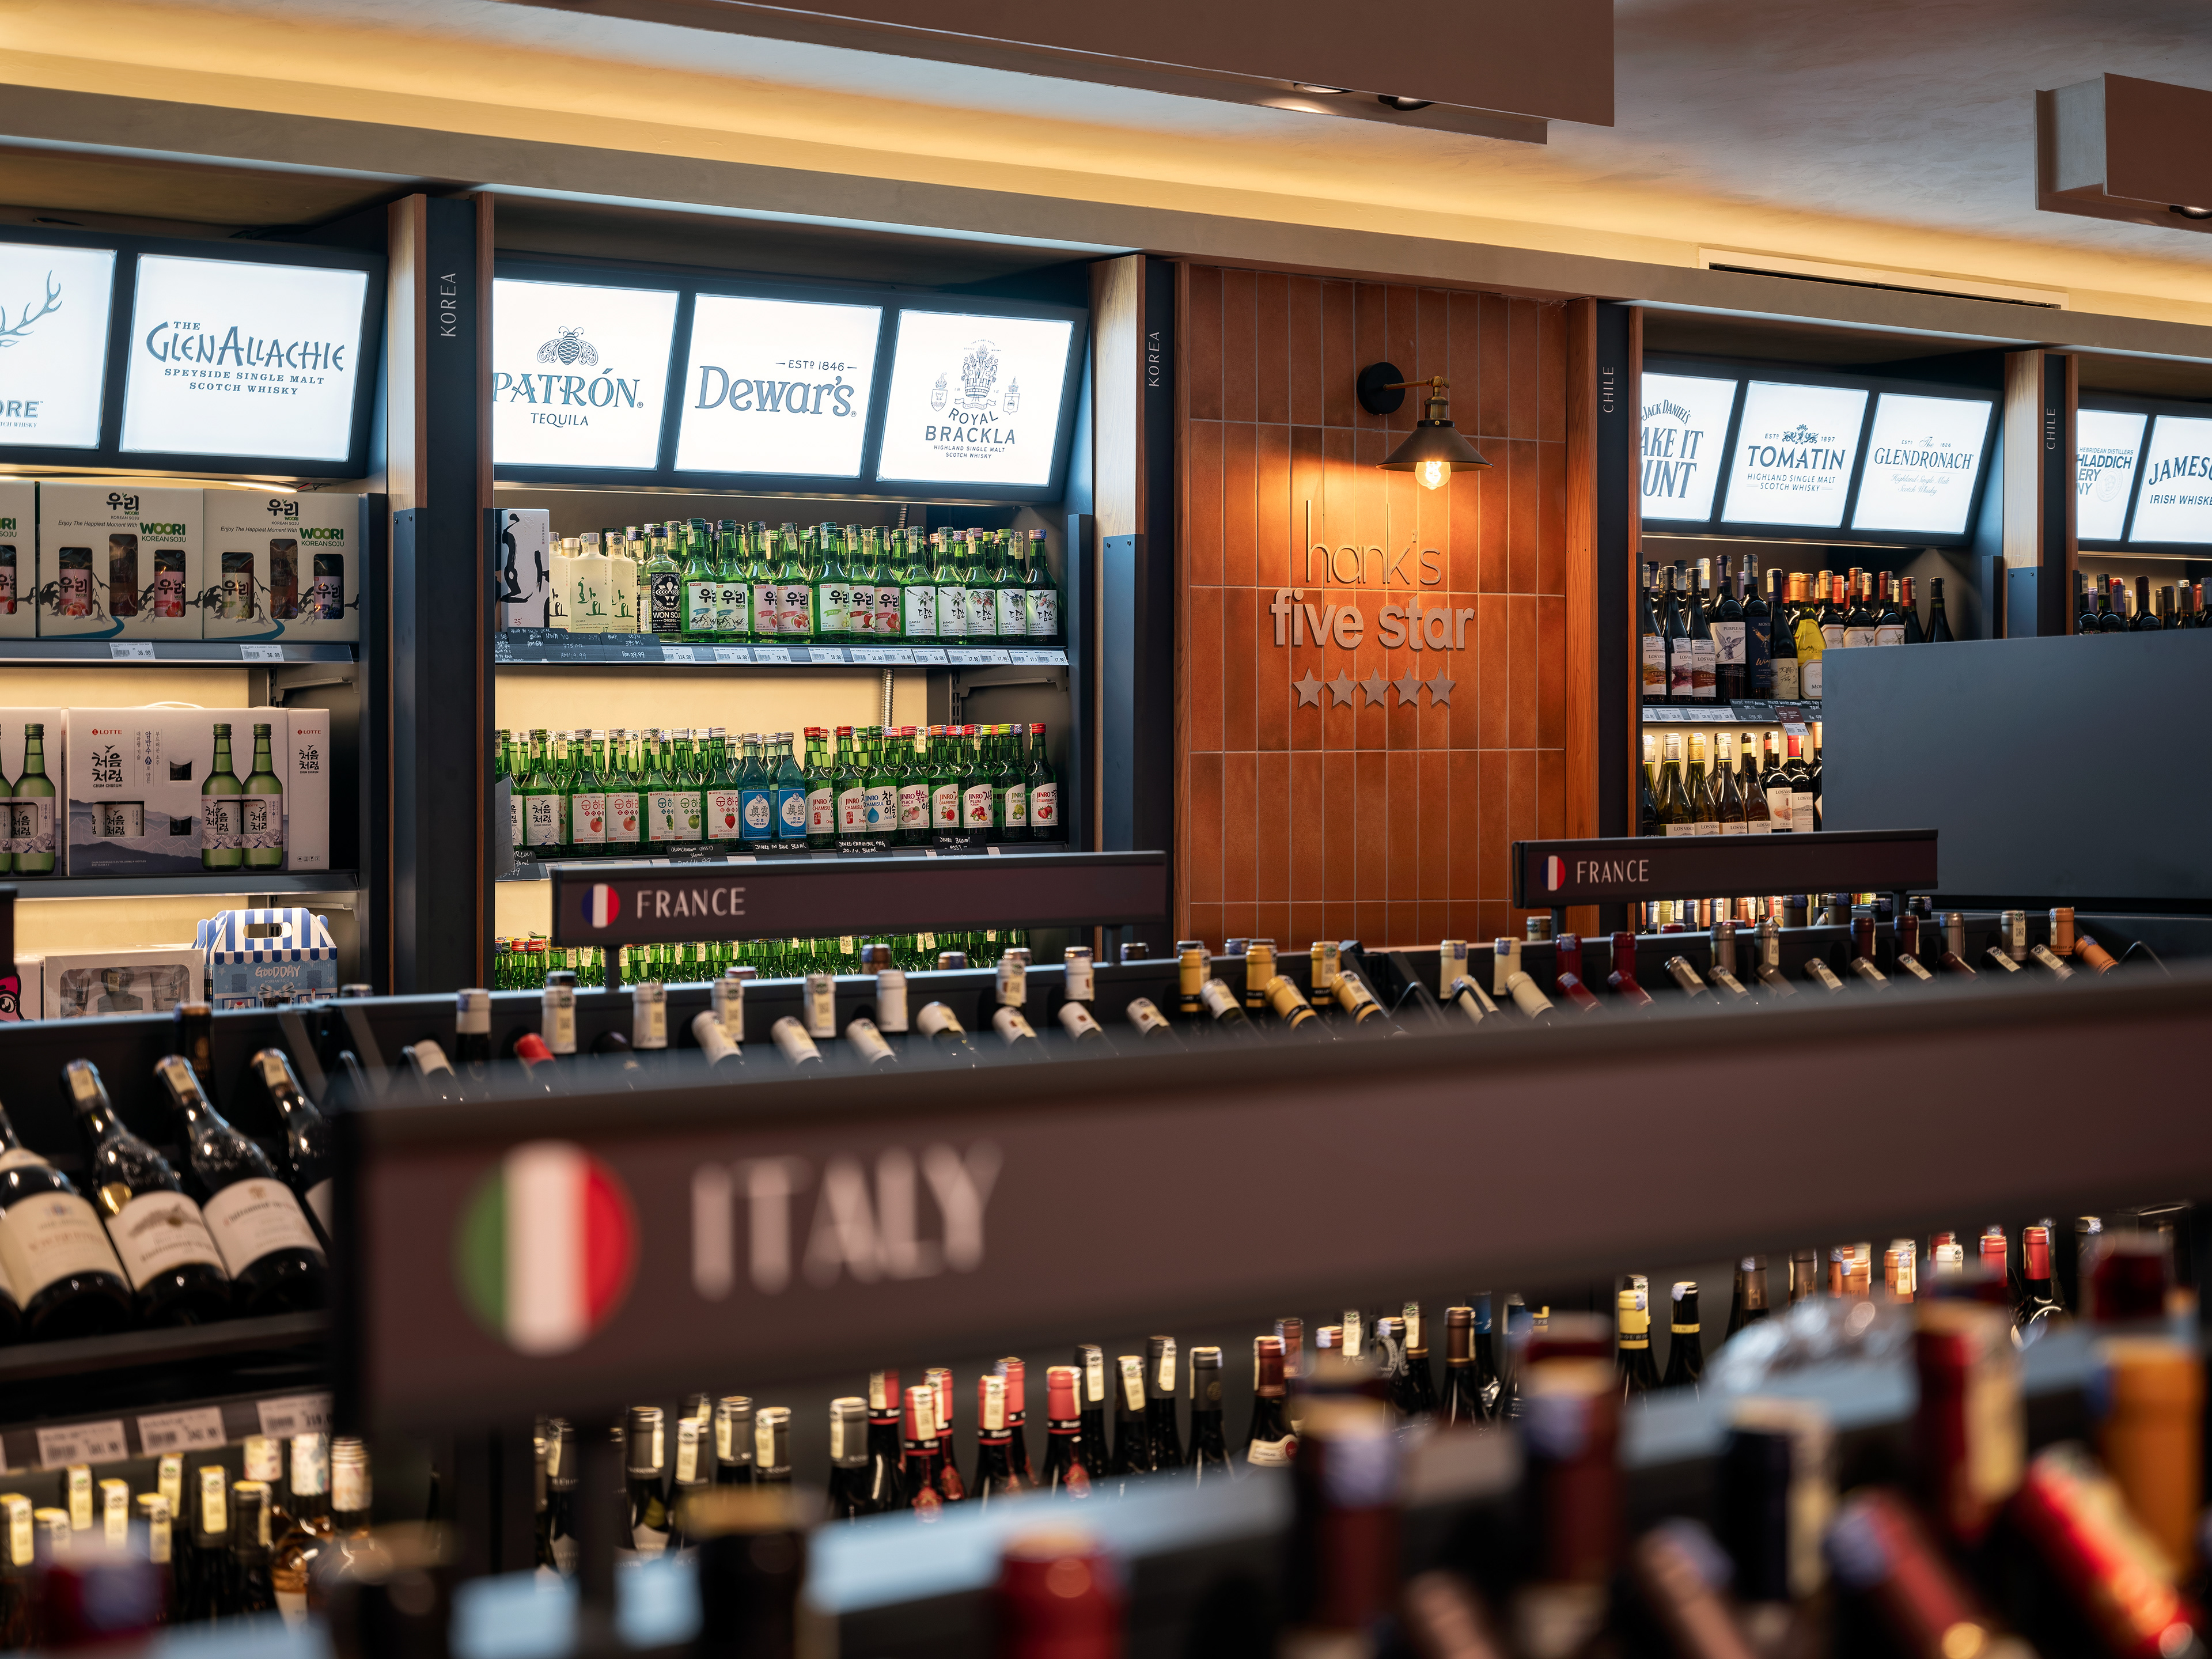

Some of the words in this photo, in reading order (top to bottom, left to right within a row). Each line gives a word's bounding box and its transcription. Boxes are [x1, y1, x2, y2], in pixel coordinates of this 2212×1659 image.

[440, 272, 456, 337] KOREA
[173, 321, 201, 330] THE
[818, 361, 844, 372] 1846
[1148, 331, 1160, 388] KOREA
[164, 368, 231, 379] SPEYSIDE
[236, 372, 285, 382] SINGLE
[290, 375, 325, 385] MALT
[190, 382, 241, 392] SCOTCH
[247, 385, 298, 395] WHISKY
[695, 365, 854, 417] Dewar's
[1603, 366, 1613, 413] CHILE
[0, 400, 39, 418] RE
[1642, 403, 1662, 422] JACK
[1663, 399, 1691, 426] DANIEL'S
[531, 412, 589, 428] TEQUILA
[948, 407, 999, 426] ROYAL
[925, 426, 1015, 445] BRACKLA
[2046, 408, 2055, 449] CHILE
[1679, 430, 1704, 459] IT
[1918, 436, 1934, 448] The
[1747, 445, 1846, 471] TOMATIN
[1874, 447, 1972, 469] GLENDRONACH
[1641, 459, 1697, 498] UNT
[1747, 473, 1787, 482] HIGHLAND
[1789, 475, 1815, 483] SINGLE
[1891, 474, 1917, 484] Highland
[1916, 475, 1934, 486] Single
[1934, 476, 1950, 484] Malt
[1760, 482, 1790, 490] SCOTCH
[1792, 483, 1820, 492] WHISKY
[1897, 484, 1916, 493] Scotch
[1918, 486, 1938, 497] Whisky
[106, 492, 139, 511] 우리
[2150, 494, 2176, 504] IRISH
[267, 498, 299, 517] 우리
[139, 522, 186, 536] WOORI
[299, 527, 344, 540] WOORI
[1305, 499, 1442, 585] hank's
[721, 590, 745, 605] 우리
[851, 592, 874, 607] 우리
[918, 607, 933, 619] 담소
[951, 608, 965, 619] 담소
[976, 609, 993, 621] 담소
[1009, 609, 1024, 622] 담소
[1037, 610, 1054, 622] 담소
[1271, 588, 1364, 649] five
[1377, 594, 1475, 650] star
[91, 752, 122, 768] 처음
[298, 749, 319, 760] 처음
[299, 760, 320, 770] 처럼
[92, 768, 123, 782] 처럼
[813, 798, 827, 806] JINRO
[865, 794, 879, 802] JINRO
[900, 793, 915, 801] JINRO
[968, 793, 983, 801] JINRO
[532, 804, 551, 815] 처음
[532, 815, 552, 823] 처럼
[1577, 859, 1649, 884] FRANCE
[637, 886, 747, 919] FRANCE
[691, 1138, 1005, 1302] ITALY
